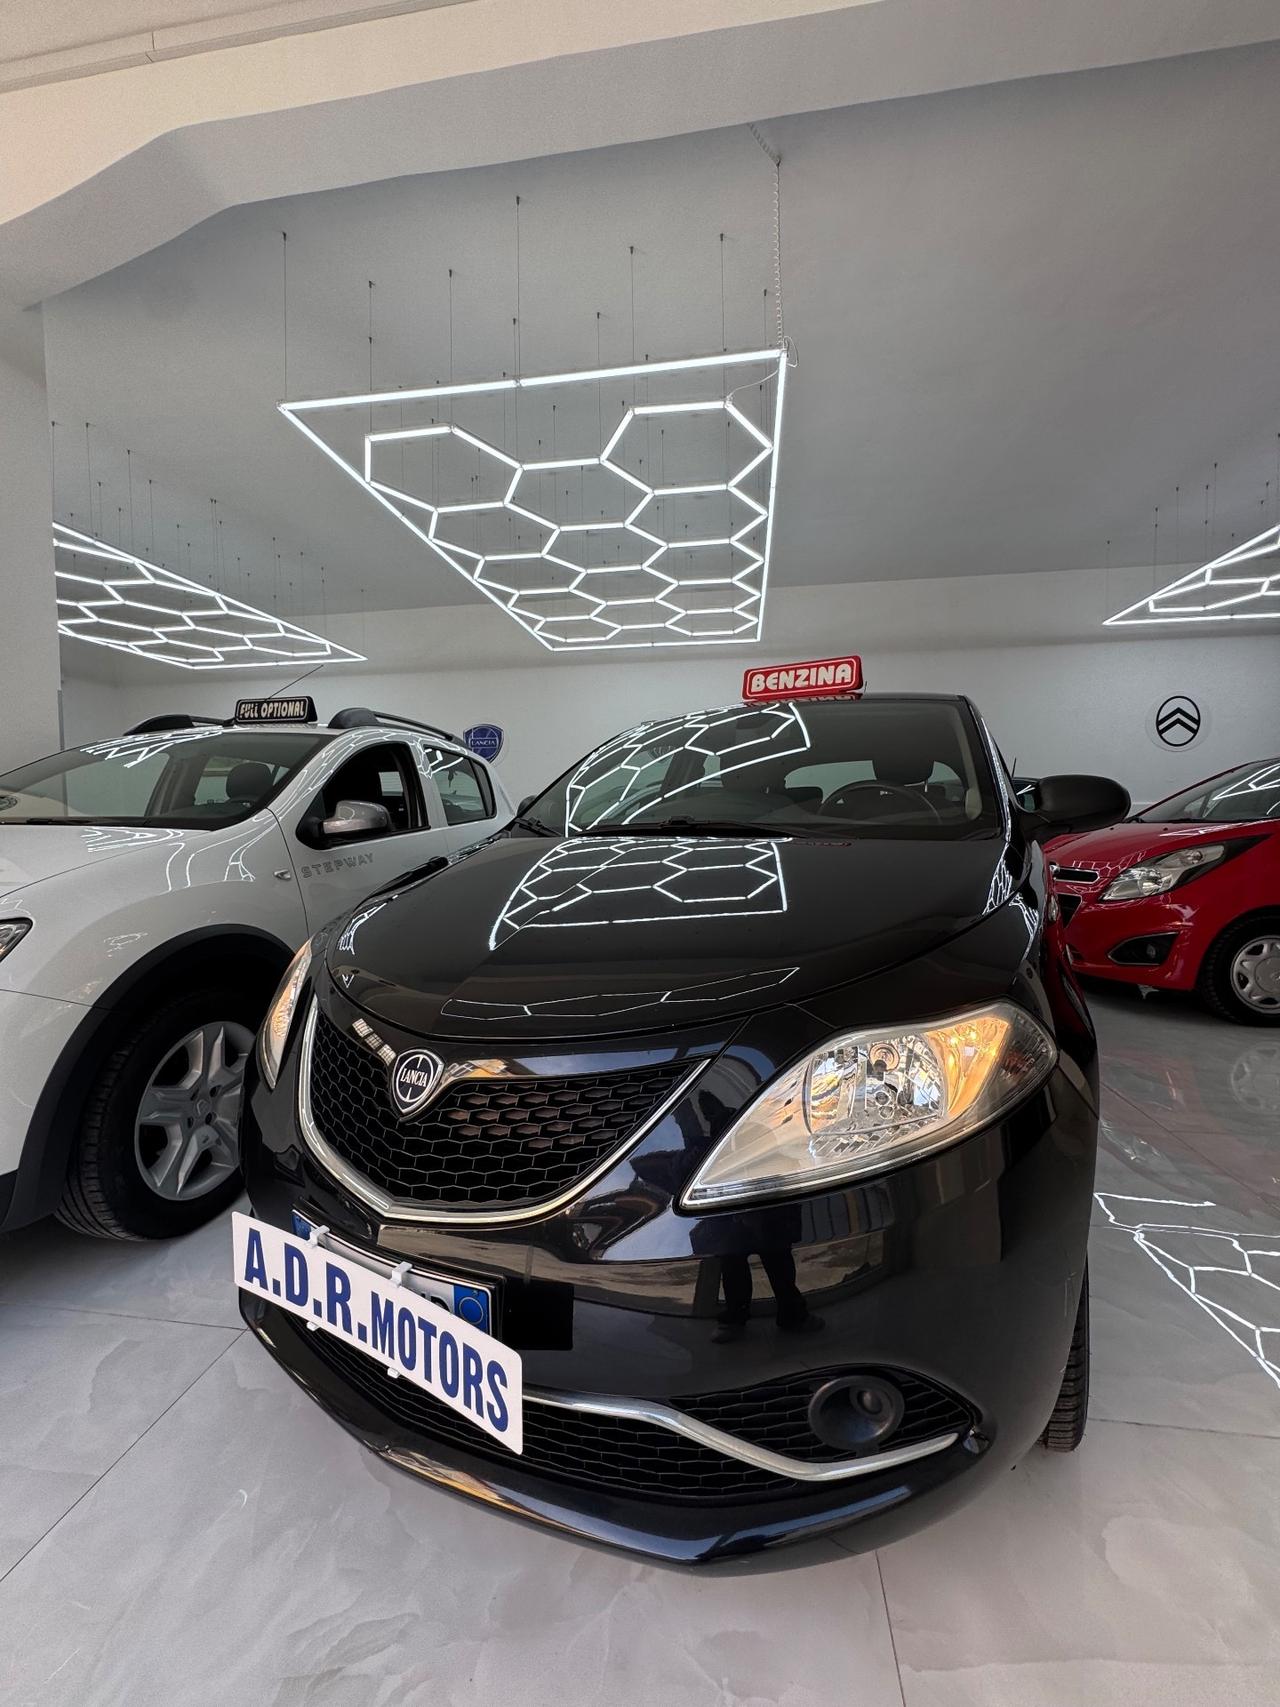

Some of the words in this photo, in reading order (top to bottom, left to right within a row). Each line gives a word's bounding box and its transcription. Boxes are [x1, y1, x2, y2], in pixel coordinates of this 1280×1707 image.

[751, 664, 852, 692] BENZINA
[240, 703, 258, 718] FULL
[261, 701, 304, 718] OPTIONAL
[301, 853, 373, 878] STEPWAY
[400, 1068, 428, 1087] LANCIA
